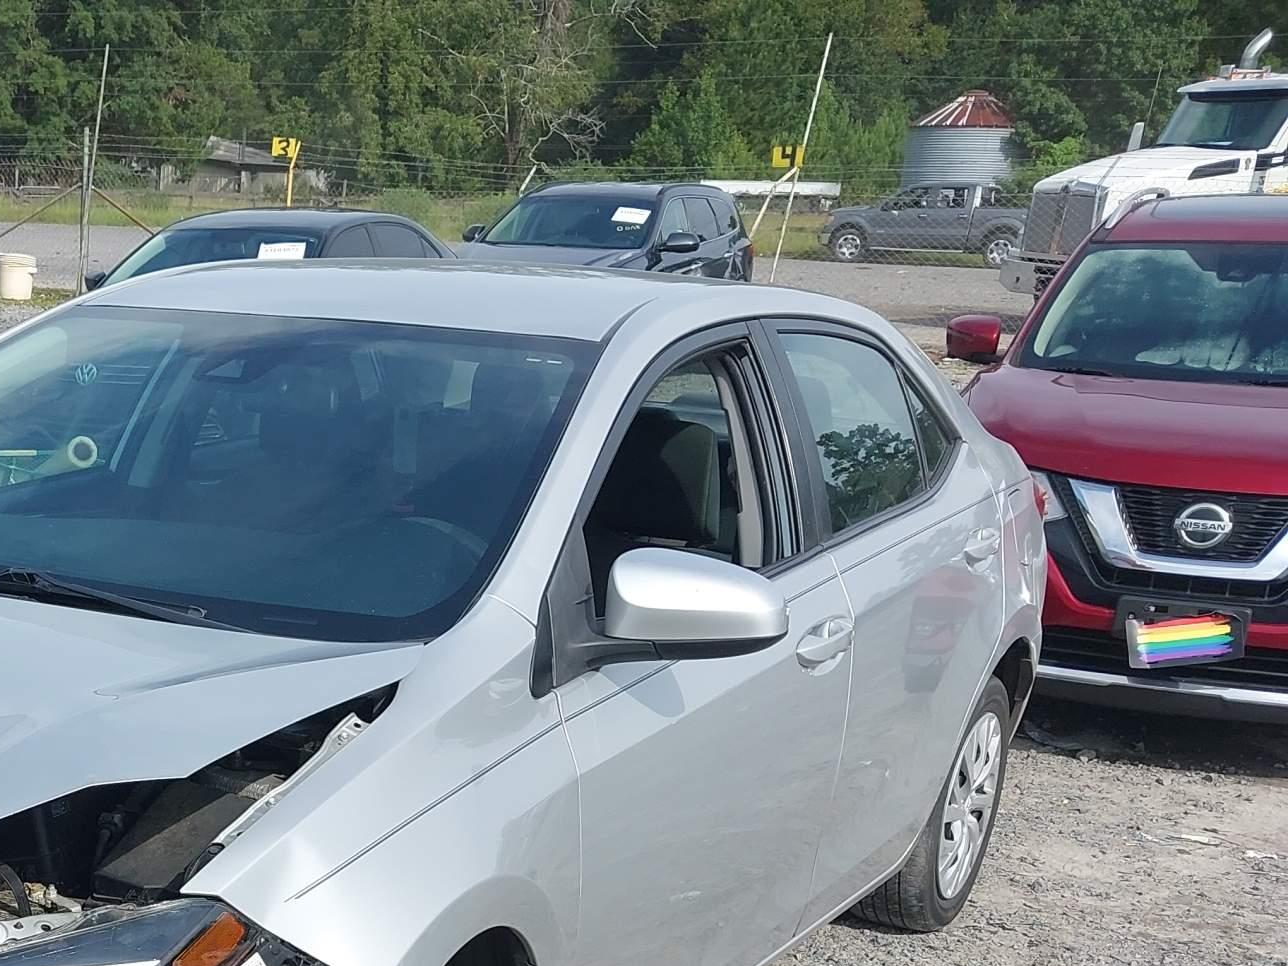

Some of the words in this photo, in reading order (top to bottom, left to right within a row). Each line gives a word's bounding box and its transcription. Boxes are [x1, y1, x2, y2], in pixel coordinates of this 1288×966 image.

[276, 138, 290, 158] 3
[781, 144, 798, 168] 4
[1180, 520, 1226, 532] NISSAN
